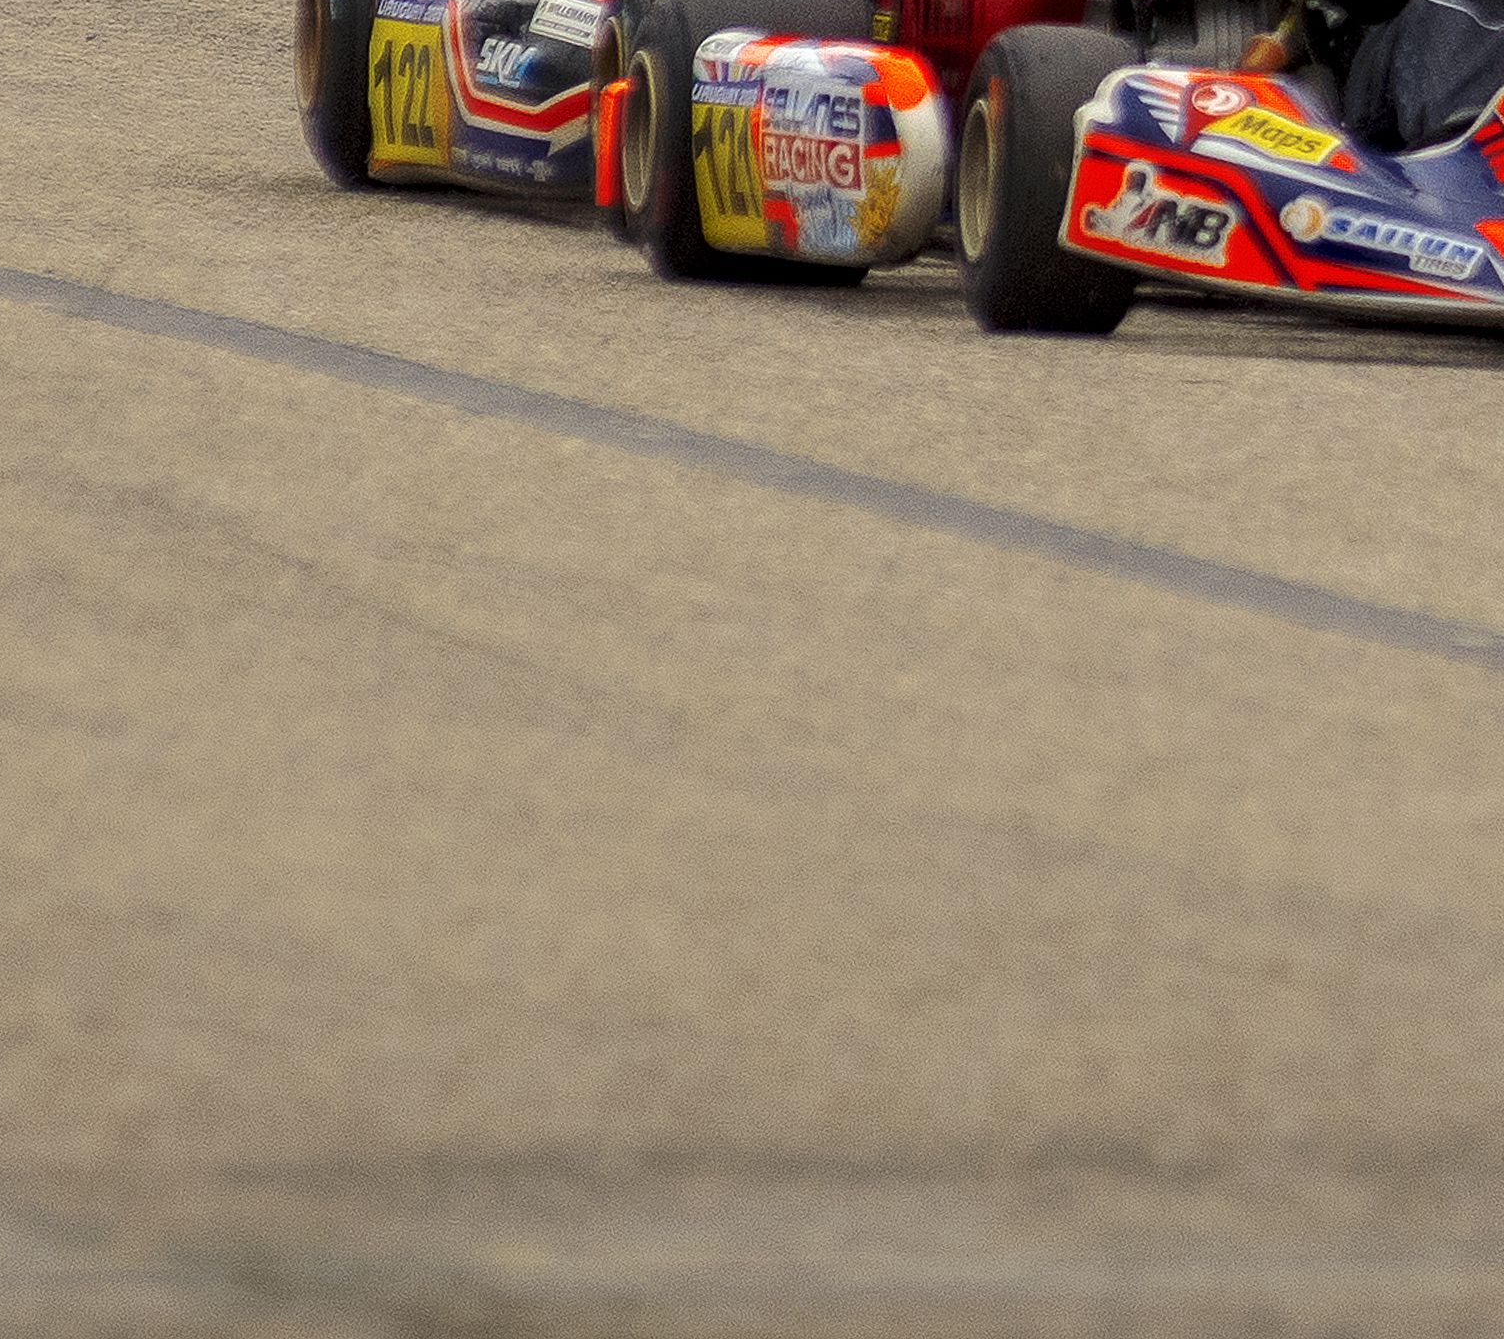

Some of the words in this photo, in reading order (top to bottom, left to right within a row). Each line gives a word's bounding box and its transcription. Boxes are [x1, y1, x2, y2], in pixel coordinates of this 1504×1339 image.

[374, 39, 436, 147] 122
[1233, 111, 1327, 157] Maps
[764, 136, 857, 188] RACING
[1330, 215, 1484, 261] SAILUN
